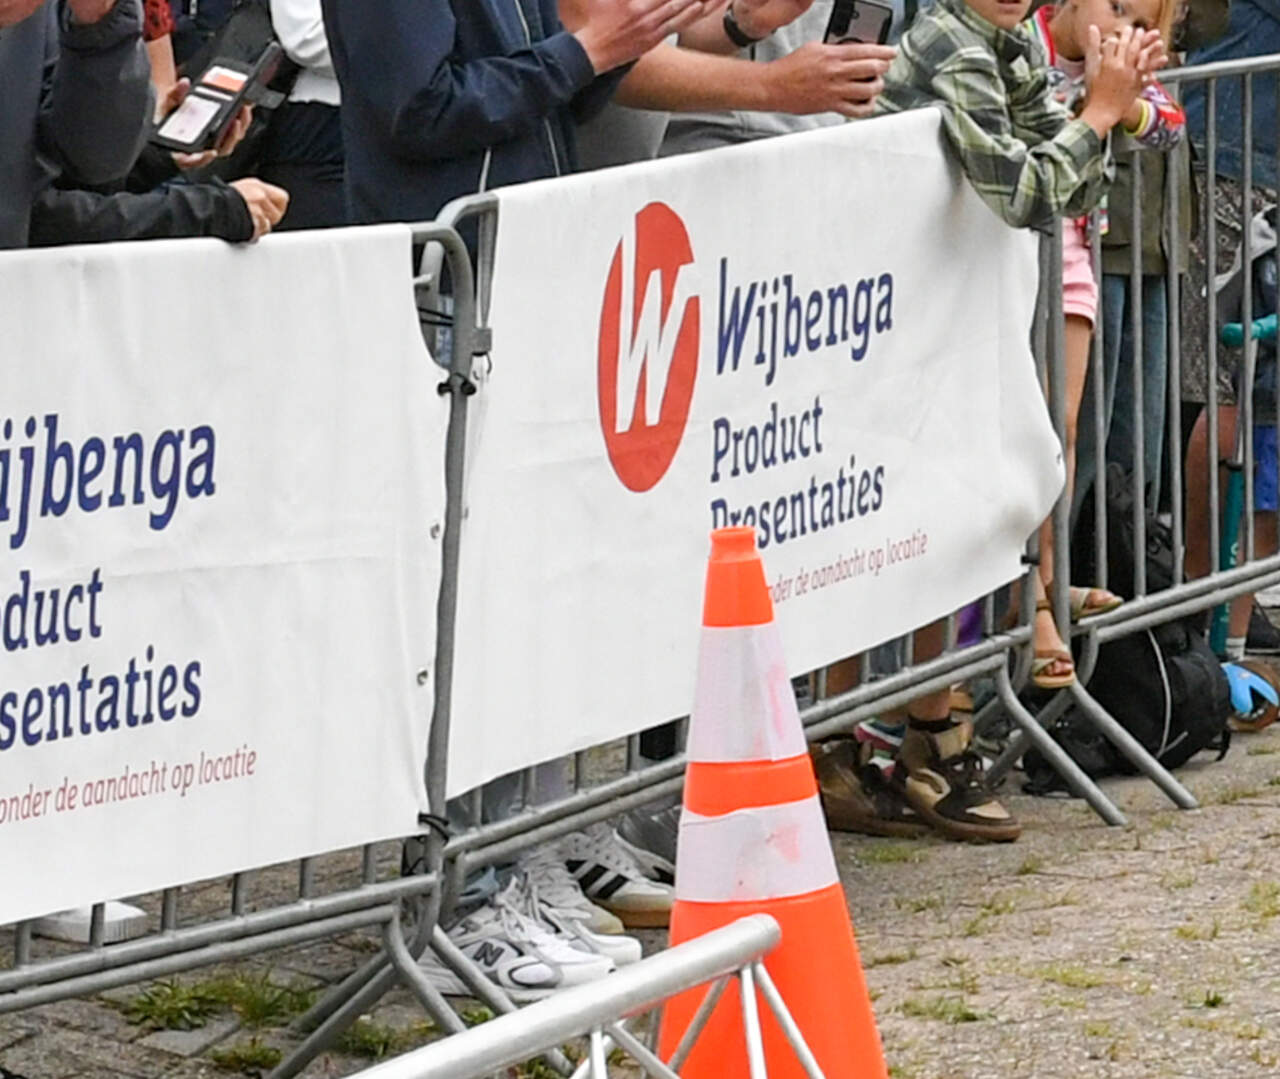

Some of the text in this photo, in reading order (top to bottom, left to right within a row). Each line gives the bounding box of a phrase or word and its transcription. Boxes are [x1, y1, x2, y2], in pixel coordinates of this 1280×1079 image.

[716, 256, 894, 387] Wijbenga
[710, 395, 824, 483] Product
[867, 547, 885, 577] op
[886, 528, 928, 567] locatie
[0, 567, 104, 652] duct
[0, 643, 202, 752] sentaties
[55, 776, 79, 812] de
[81, 760, 168, 808] aandacht
[170, 762, 195, 798] op
[198, 743, 257, 786] locatie
